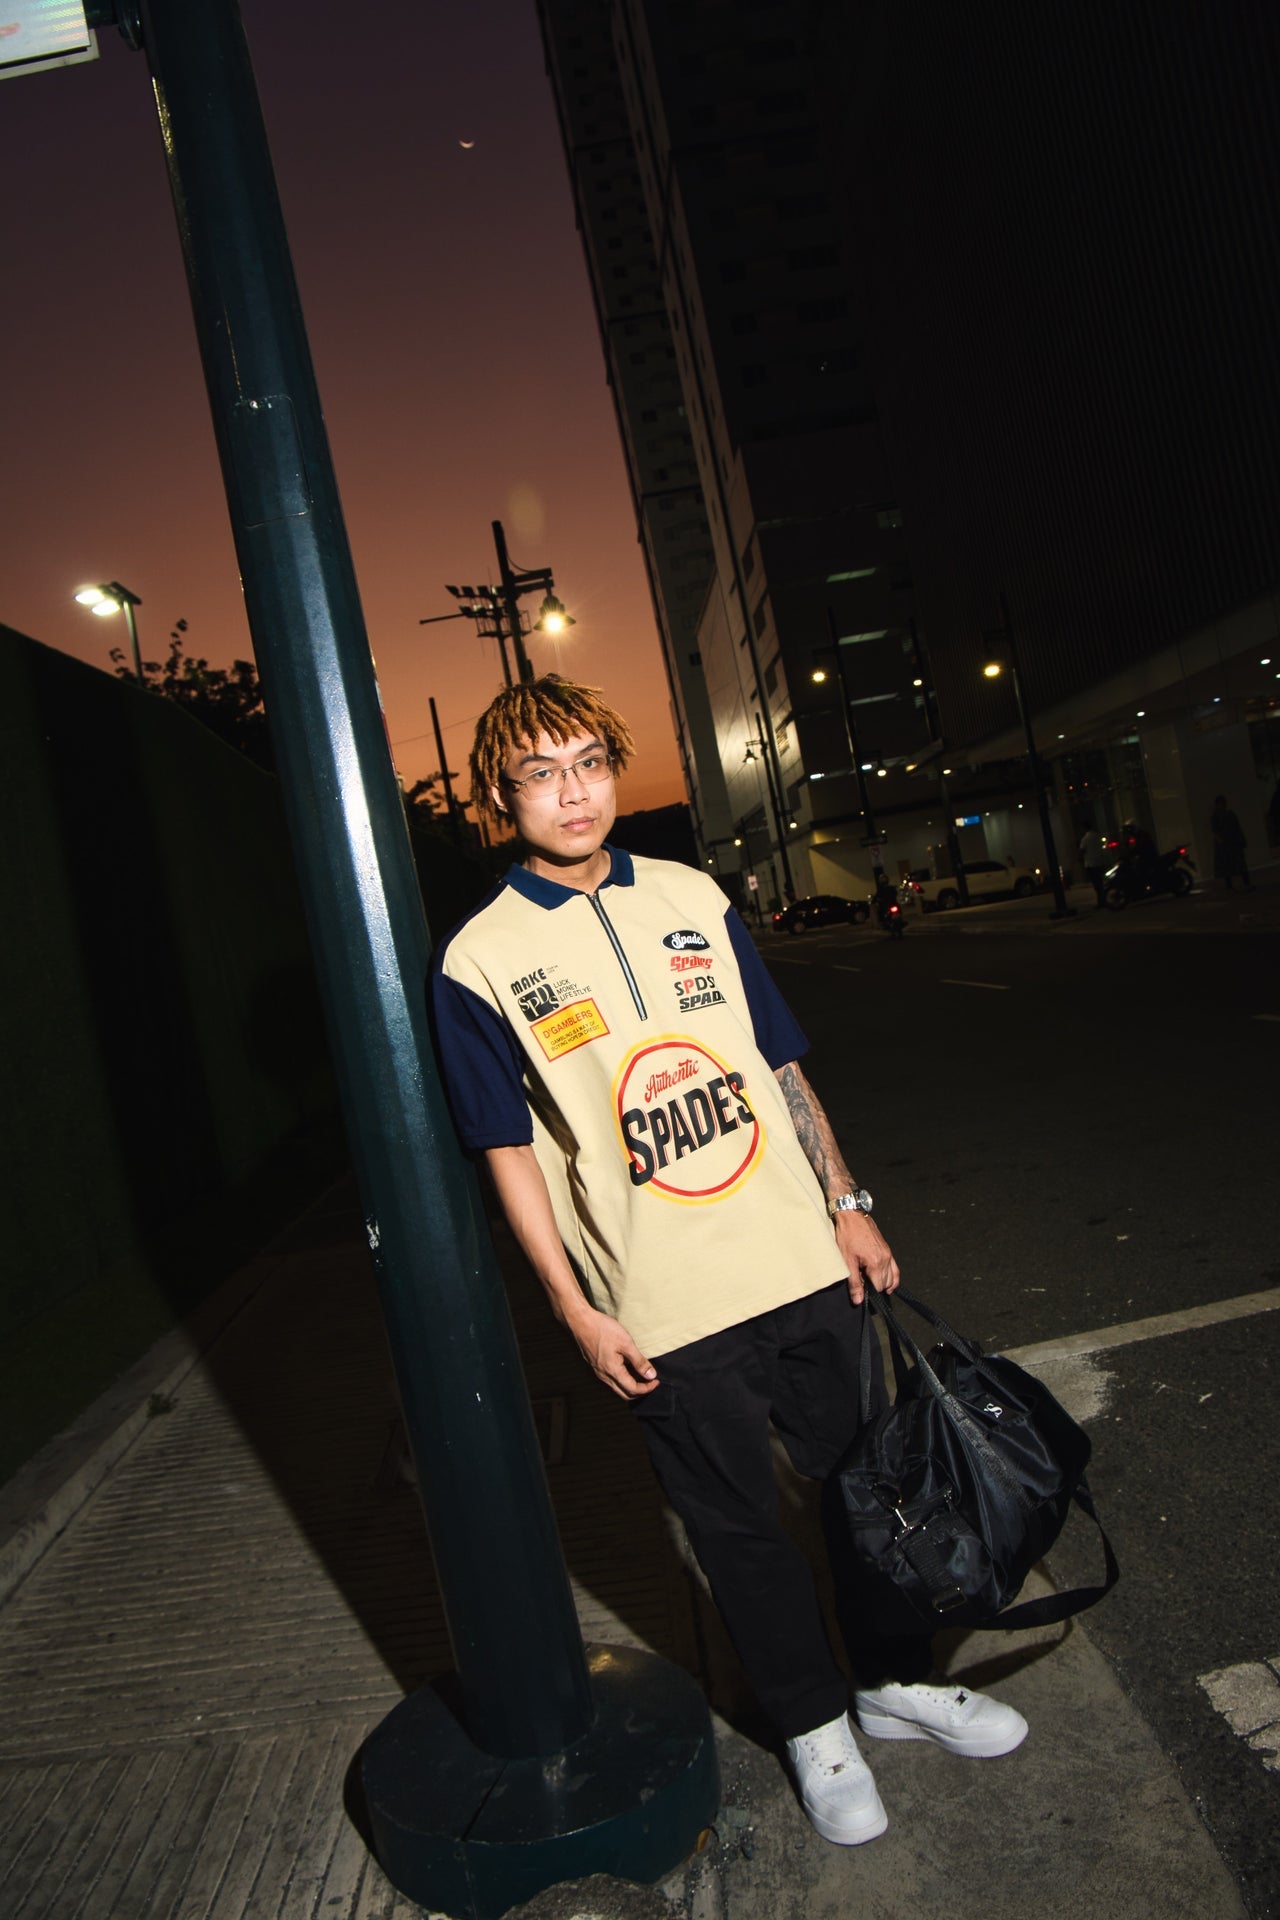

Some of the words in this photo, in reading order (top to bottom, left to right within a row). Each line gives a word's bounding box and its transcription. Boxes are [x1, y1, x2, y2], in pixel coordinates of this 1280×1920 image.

[671, 932, 706, 949] Spades
[510, 968, 547, 996] MAKE
[553, 978, 571, 989] LUCK
[556, 983, 578, 995] MONEY
[674, 975, 716, 996] SPDS
[542, 1009, 593, 1039] D'GAMBLERS
[644, 1058, 700, 1104] Authentic
[621, 1071, 756, 1187] SPADES
